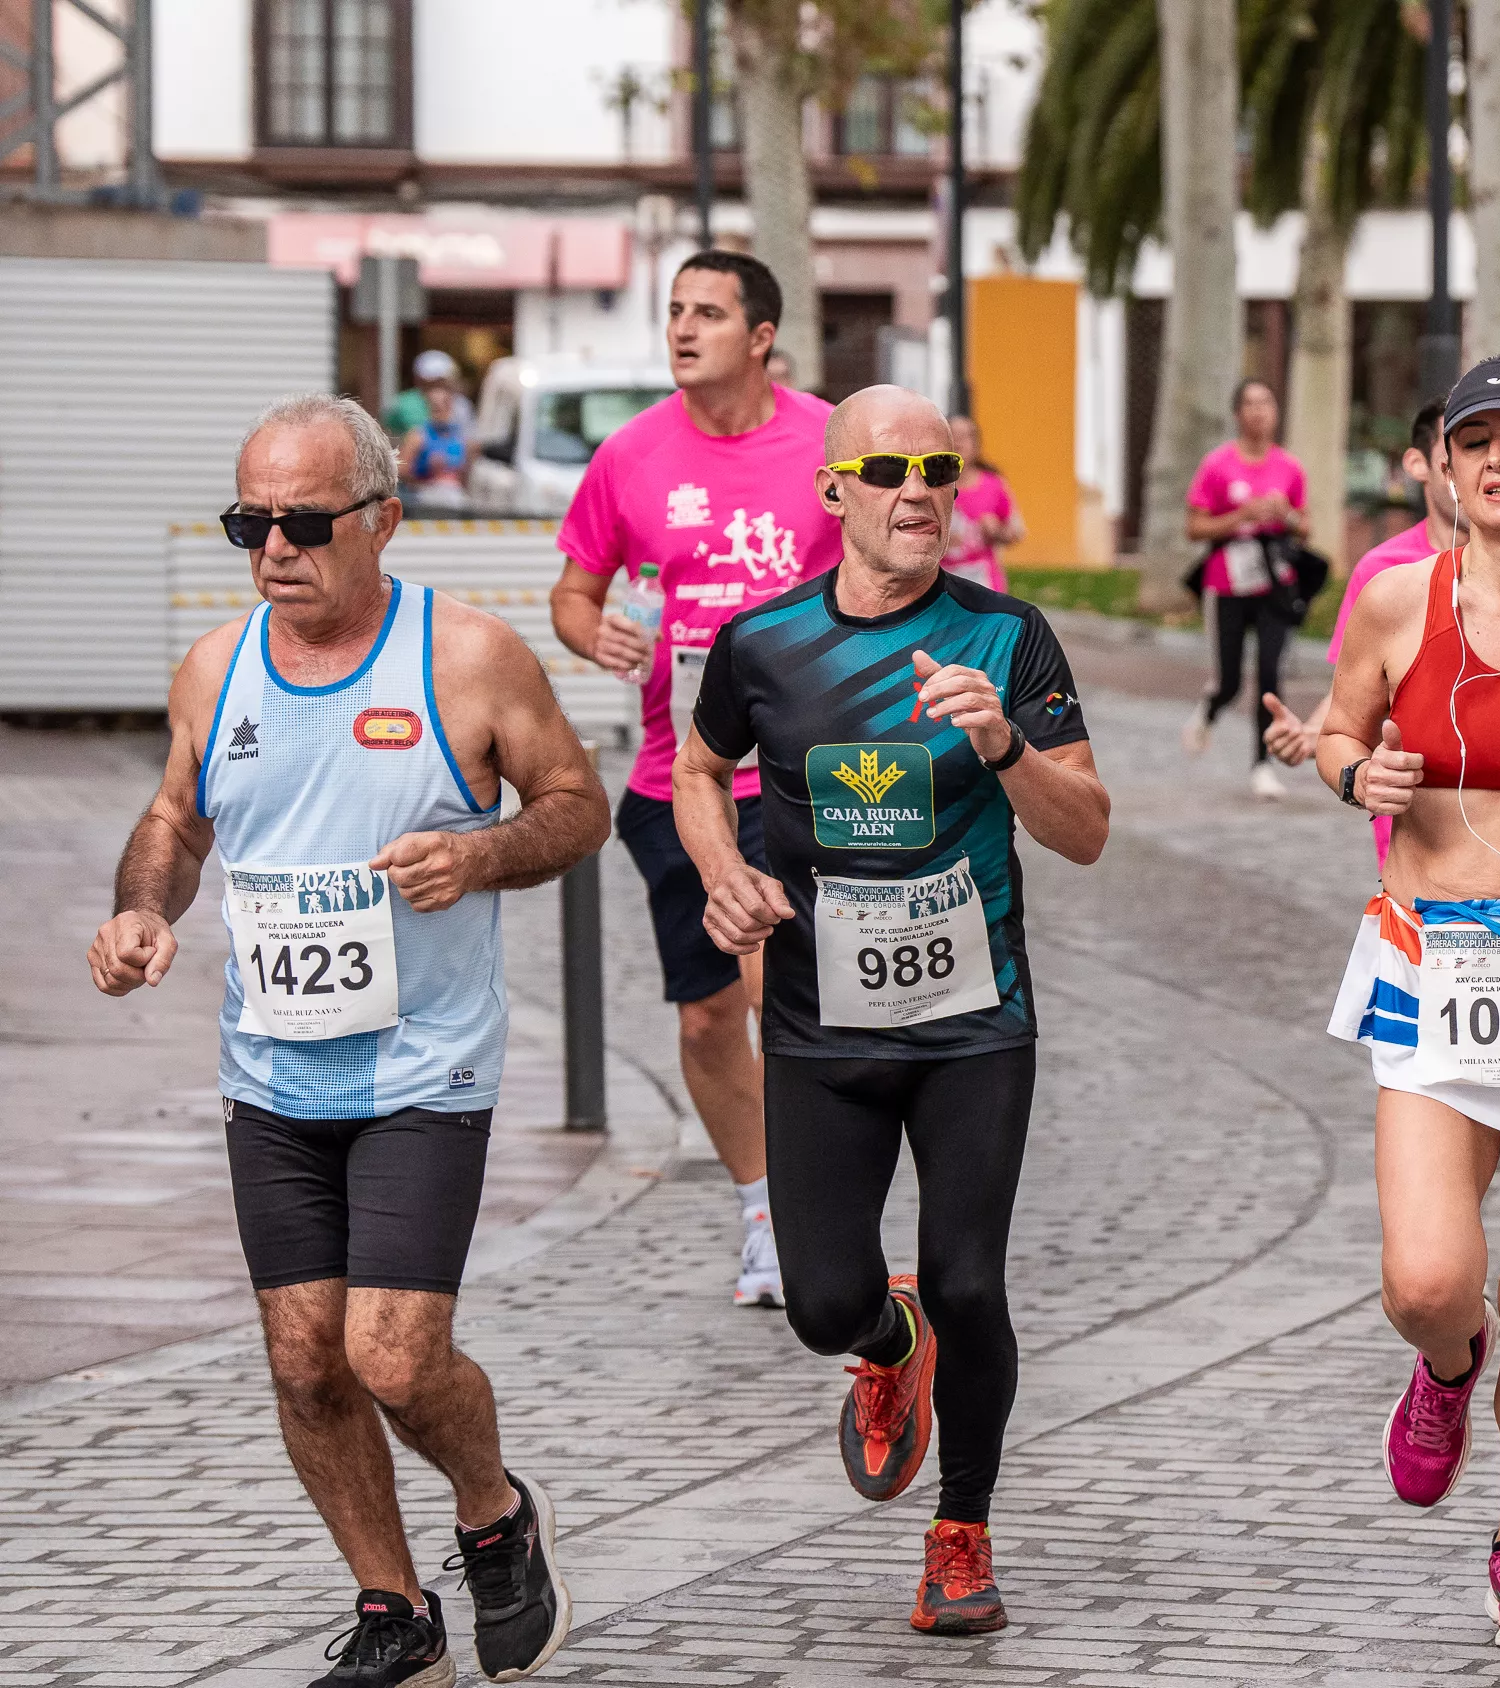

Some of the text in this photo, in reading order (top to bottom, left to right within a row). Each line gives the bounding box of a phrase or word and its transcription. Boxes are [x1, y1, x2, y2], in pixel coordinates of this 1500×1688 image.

[228, 747, 259, 761] luanvi
[822, 807, 924, 822] CAJA RURAL
[852, 821, 895, 837] JAÉN
[249, 873, 282, 884] PROVINCIAL
[284, 875, 294, 883] DE
[296, 869, 346, 892] 2024
[232, 880, 294, 892] CARRERAS POPULARES
[823, 881, 904, 895] CIRCUITO PROVINCIAL DE
[905, 875, 949, 901] 2024
[823, 888, 905, 902] CARRERAS POPULARES
[257, 922, 267, 930] XXV
[268, 922, 279, 930] C.P.
[280, 922, 304, 930] CIUDAD
[315, 920, 345, 929] LUCENA
[859, 927, 874, 935] XXV
[888, 926, 913, 935] CIUDAD
[924, 917, 949, 929] LUCENA
[290, 932, 326, 940] IGUALDAD
[900, 930, 934, 942] IGUALDAD
[1450, 931, 1493, 940] PROVINCIAL
[1426, 940, 1457, 948] CARRERAS
[251, 941, 373, 995] 1423
[857, 937, 955, 990] 988
[887, 999, 908, 1008] LUNA
[908, 988, 951, 1003] FERNÁNDEZ
[272, 1006, 342, 1017] RAFAEL RUIZ NAVAS
